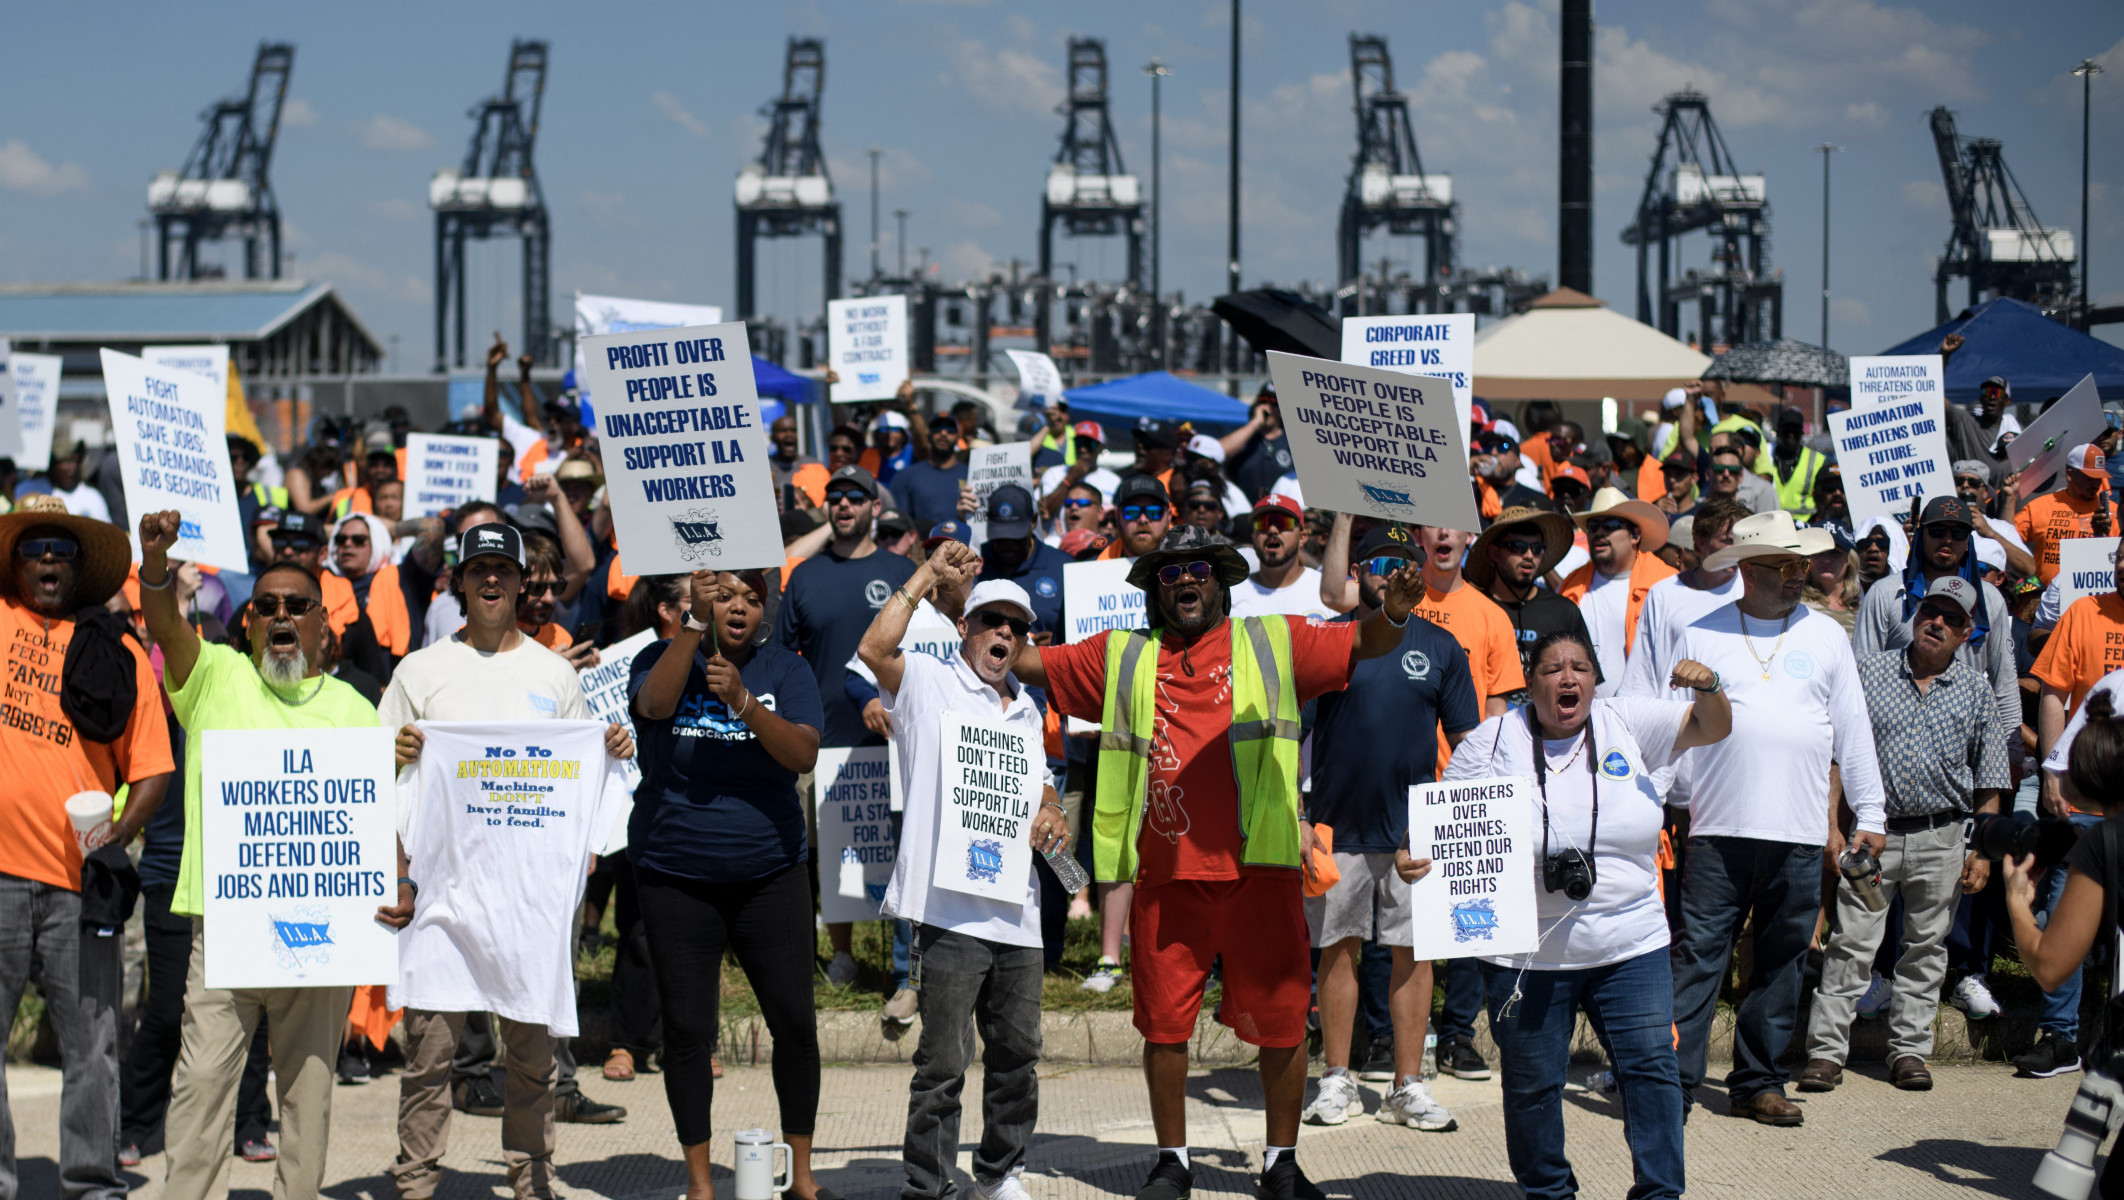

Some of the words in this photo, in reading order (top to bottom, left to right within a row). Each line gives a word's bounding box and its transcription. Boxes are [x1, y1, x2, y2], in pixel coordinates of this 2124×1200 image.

[845, 308, 858, 319] NO
[861, 306, 888, 318] WORK
[846, 321, 888, 334] WITHOUT
[1366, 324, 1451, 343] CORPORATE
[853, 337, 860, 347] A
[862, 335, 882, 347] FAIR
[607, 342, 668, 370] PROFIT
[674, 338, 725, 365] OVER
[843, 350, 892, 363] CONTRACT
[1371, 350, 1415, 366] GREED
[1420, 349, 1443, 365] VS.
[1866, 366, 1926, 378] AUTOMATION
[145, 377, 178, 402] FIGHT
[626, 374, 694, 403] PEOPLE
[697, 373, 717, 397] IS
[1302, 370, 1367, 396] PROFIT
[1374, 383, 1424, 405] OVER
[1859, 380, 1912, 392] THREATENS
[1916, 380, 1935, 391] OUR
[128, 395, 208, 435] AUTOMATION,
[1320, 392, 1391, 419] PEOPLE
[1396, 405, 1415, 422] IS
[1846, 402, 1923, 431] AUTOMATION
[605, 405, 751, 438] UNACCEPTABLE:
[1297, 407, 1447, 446] UNACCEPTABLE:
[137, 420, 168, 445] SAVE
[172, 429, 205, 453] JOBS:
[1315, 428, 1400, 456] SUPPORT
[1406, 443, 1438, 462] ILA
[1841, 426, 1908, 451] THREATENS
[1911, 419, 1936, 436] OUR
[427, 444, 477, 456] MACHINES
[624, 442, 706, 470] SUPPORT
[712, 440, 744, 464] ILA
[986, 452, 1008, 465] FIGHT
[1869, 444, 1917, 465] FUTURE:
[135, 443, 155, 464] ILA
[158, 448, 217, 479] DEMANDS
[1333, 449, 1427, 478] WORKERS
[972, 465, 1024, 481] AUTOMATION,
[1860, 468, 1900, 487] STAND
[1903, 459, 1935, 478] WITH
[139, 468, 161, 489] JOB
[165, 473, 220, 502] SECURITY
[642, 474, 736, 503] WORKERS
[975, 482, 995, 494] SAVE
[1880, 488, 1900, 502] THE
[1904, 482, 1924, 498] ILA
[2049, 519, 2070, 527] FEED
[2052, 511, 2081, 519] PEOPLE
[2045, 542, 2060, 550] NOT
[1098, 595, 1117, 611] NO
[1941, 588, 1962, 598] ARIAT
[1076, 613, 1133, 634] WITHOUT
[10, 643, 48, 667] FEED
[8, 659, 61, 696] FAMIL
[5, 682, 33, 705] NOT
[0, 703, 73, 748] ROBOTS!
[672, 727, 746, 741] DEMOCRATIC
[679, 717, 726, 730] HARRIS
[961, 725, 1024, 754] MACHINES
[283, 749, 313, 774] ILA
[485, 747, 516, 757] No
[526, 746, 552, 757] To
[958, 746, 995, 769] DON'T
[1000, 753, 1027, 775] FEED
[457, 760, 580, 779] AUTOMATION!
[837, 761, 889, 780] AUTOMA
[481, 781, 554, 792] Machines
[963, 768, 1023, 795] FAMILIES:
[221, 780, 319, 806] WORKERS
[325, 779, 376, 804] OVER
[490, 793, 545, 803] DON'T
[824, 784, 867, 802] HURTS
[953, 787, 1009, 814] SUPPORT
[1012, 799, 1028, 819] ILA
[1426, 790, 1445, 805] ILA
[1450, 784, 1513, 802] WORKERS
[467, 804, 501, 815] have
[507, 805, 565, 817] families
[842, 804, 863, 822] ILA
[868, 803, 890, 821] STA
[1453, 803, 1486, 820] OVER
[244, 810, 353, 836] MACHINES:
[487, 818, 501, 826] to
[507, 817, 544, 828] feed.
[854, 824, 879, 842] FOR
[962, 810, 1018, 839] WORKERS
[1435, 819, 1506, 840] MACHINES:
[239, 841, 315, 868] DEFEND
[321, 841, 360, 866] OUR
[1432, 840, 1482, 860] DEFEND
[1486, 837, 1512, 855] OUR
[1442, 860, 1472, 878] JOBS
[1477, 858, 1504, 875] AND
[215, 874, 262, 899] JOBS
[268, 873, 309, 898] AND
[315, 871, 385, 897] RIGHTS
[1450, 877, 1497, 895] RIGHTS
[1460, 913, 1489, 925] I.L.A.
[284, 926, 327, 943] I.L.A.
